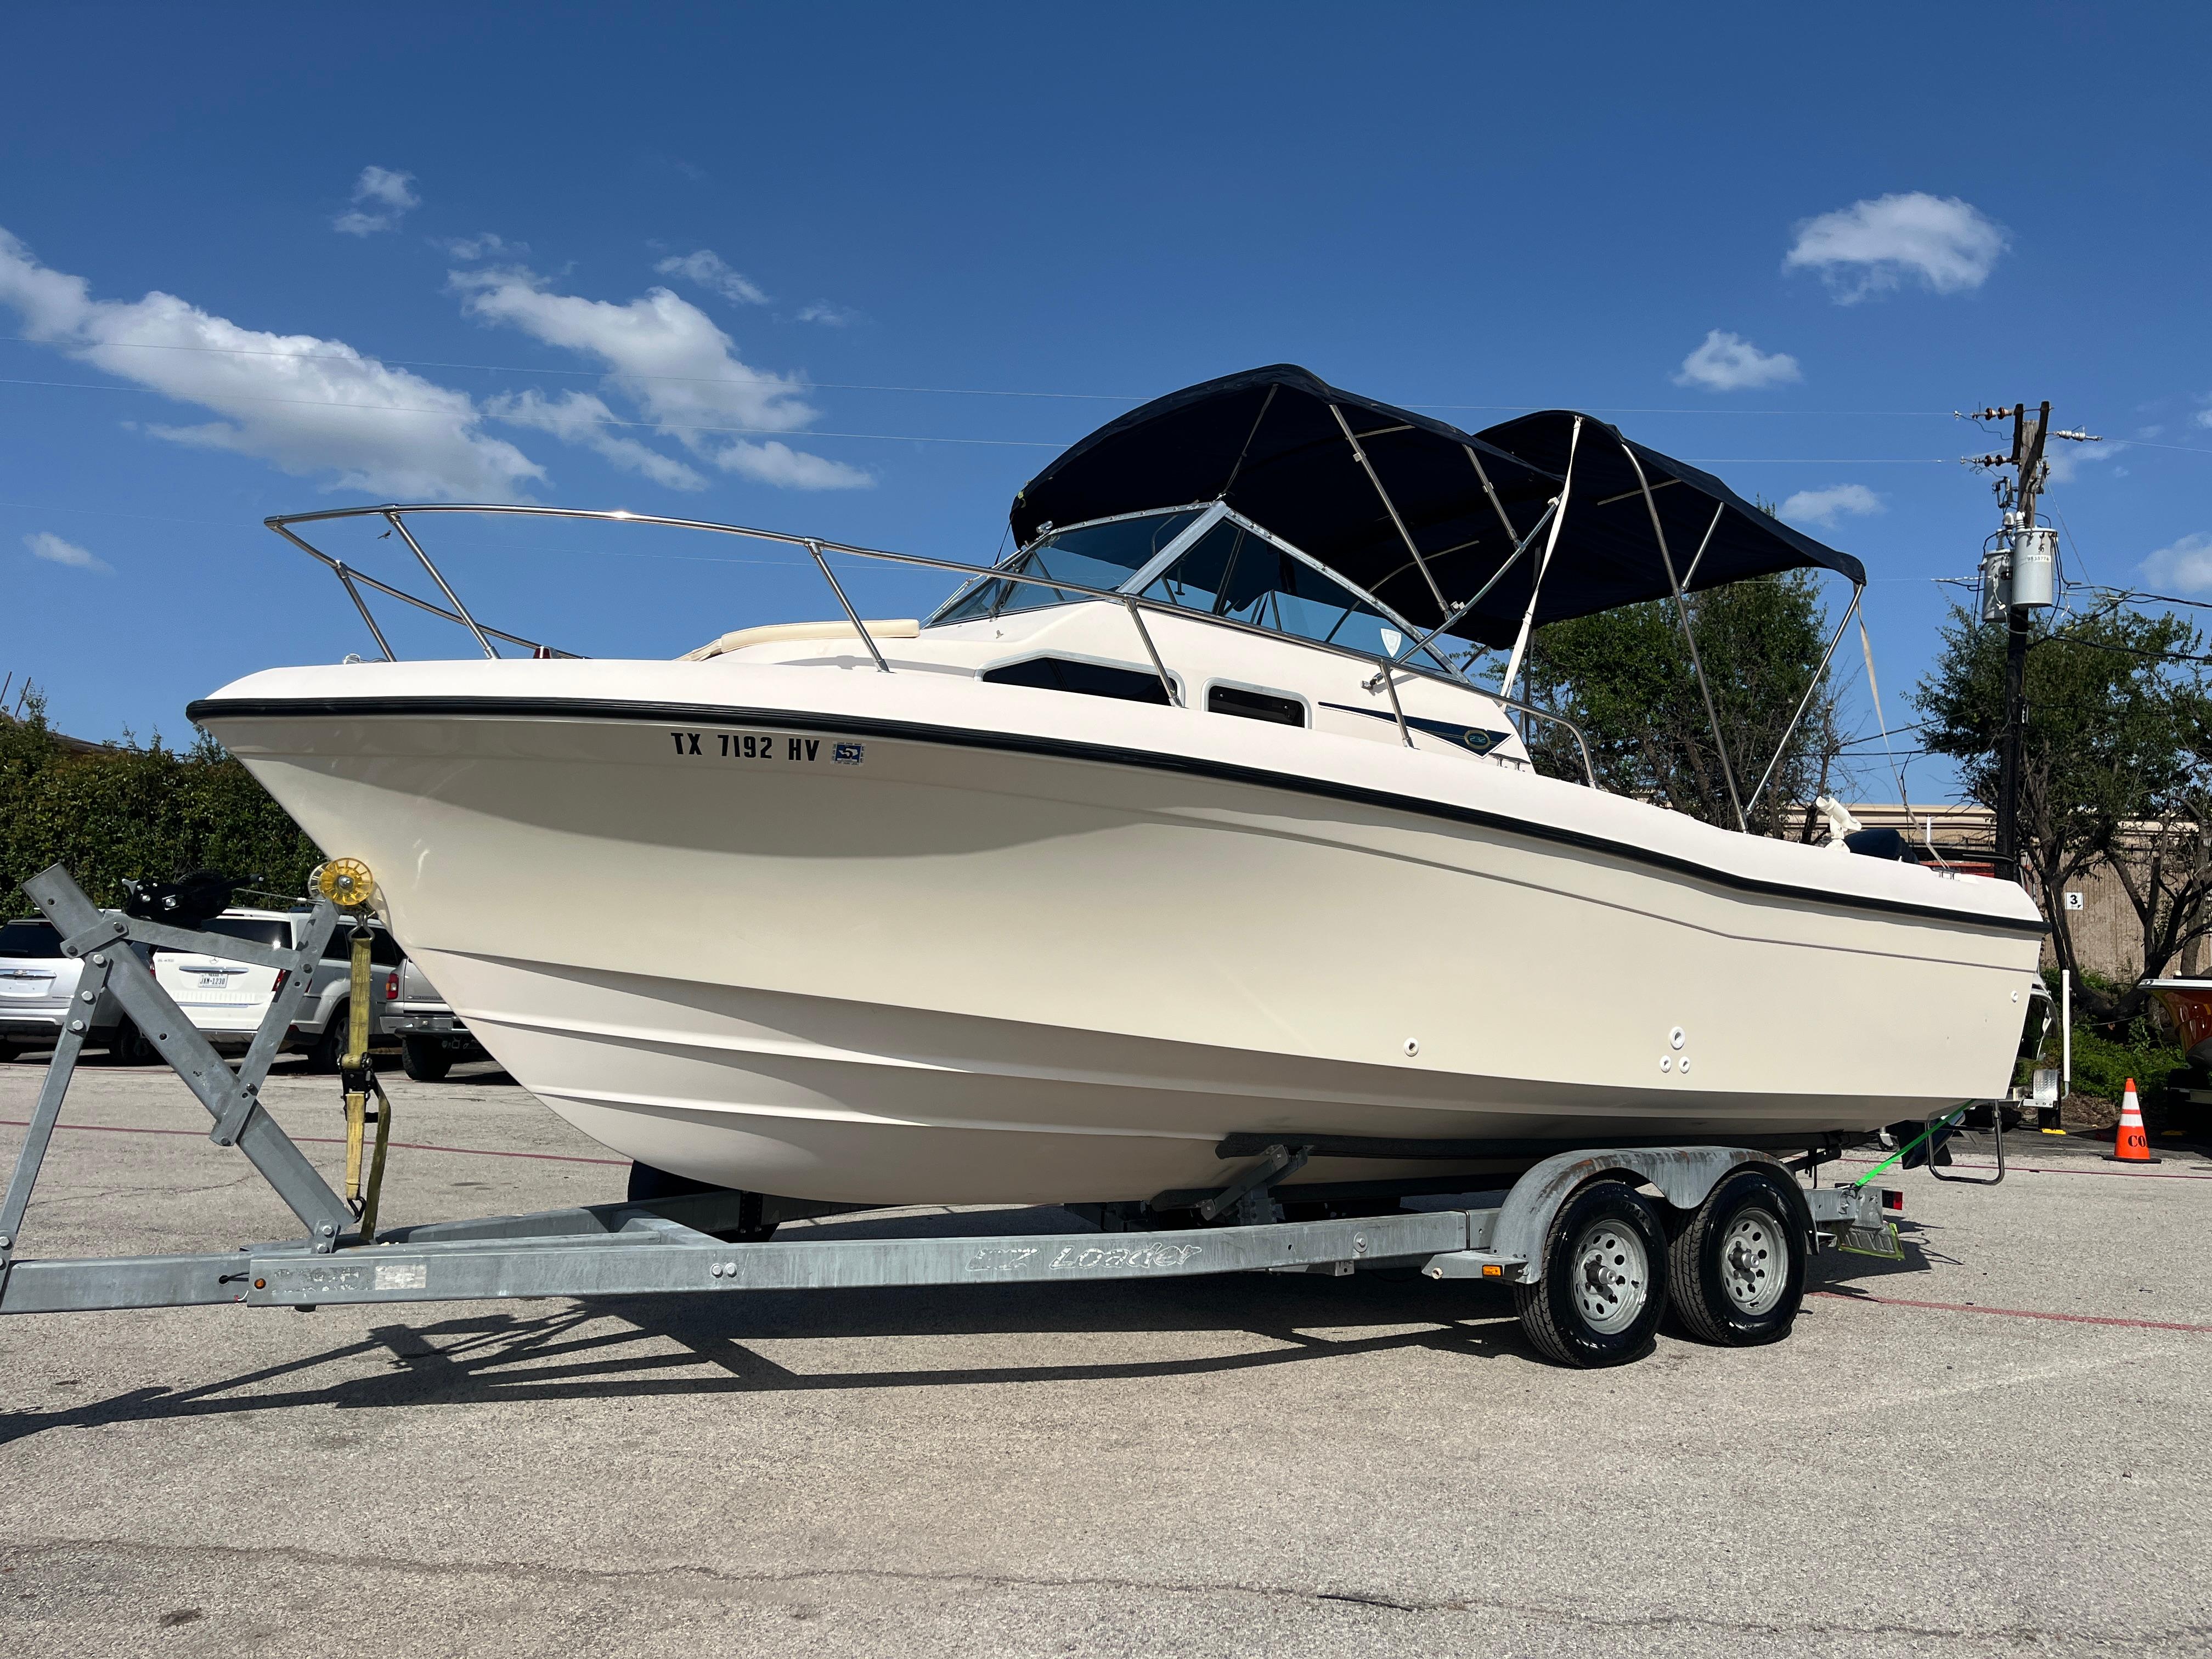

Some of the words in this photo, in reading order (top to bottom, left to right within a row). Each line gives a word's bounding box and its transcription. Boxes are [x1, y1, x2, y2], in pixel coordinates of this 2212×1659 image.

[1470, 735, 1486, 743] 232
[670, 732, 703, 755] TX
[718, 735, 772, 759] 7192
[788, 738, 820, 761] HV
[842, 746, 853, 759] 5
[2070, 894, 2078, 904] 3
[1049, 1243, 1202, 1269] Loader
